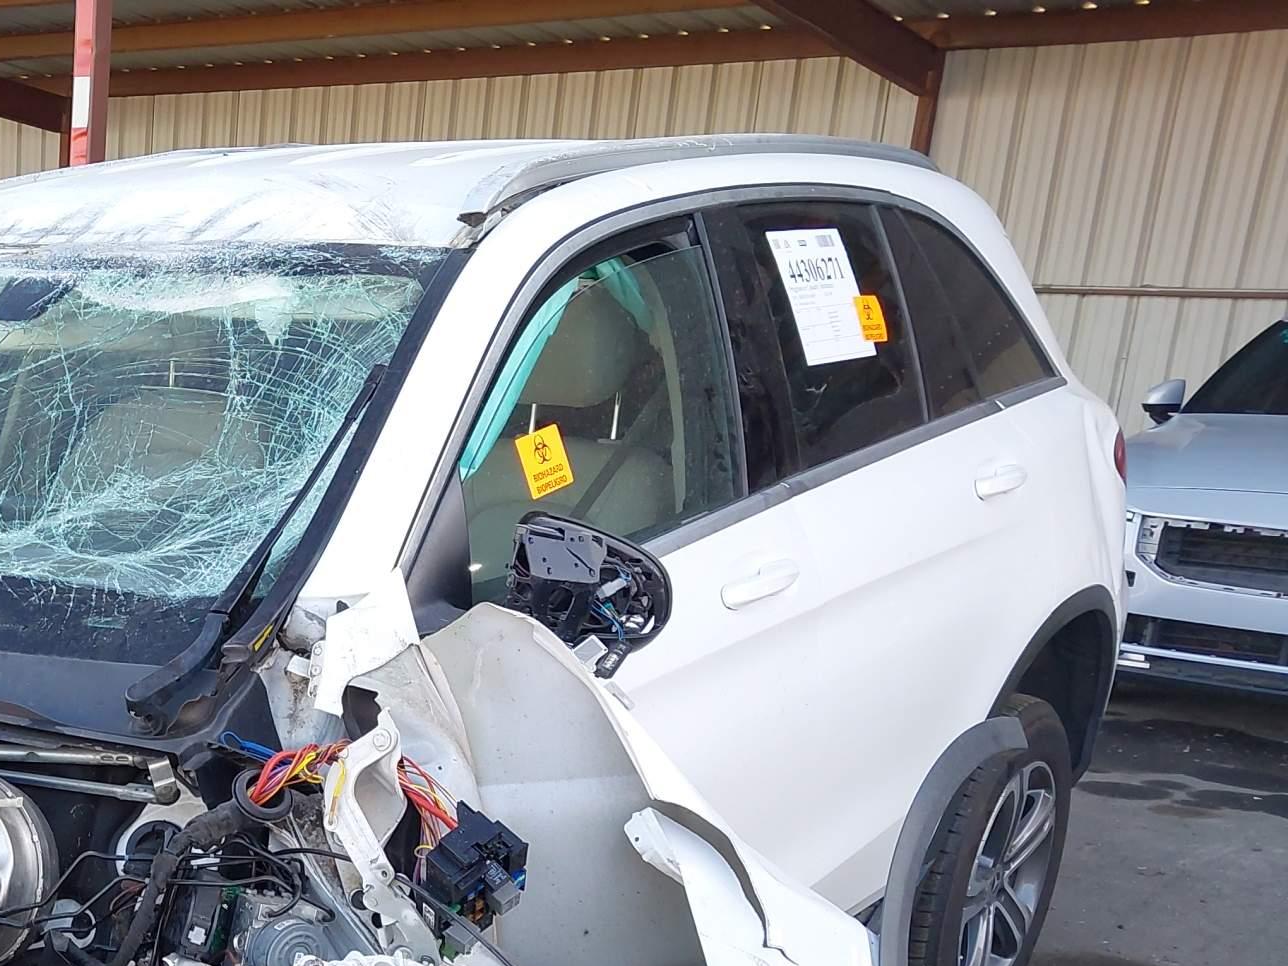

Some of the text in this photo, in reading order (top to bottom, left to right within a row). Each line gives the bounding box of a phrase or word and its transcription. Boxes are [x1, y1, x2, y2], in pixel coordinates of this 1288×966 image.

[788, 257, 845, 283] 44306271
[533, 464, 564, 482] BIOHAZARD
[536, 475, 568, 494] BIOPELIGRO
